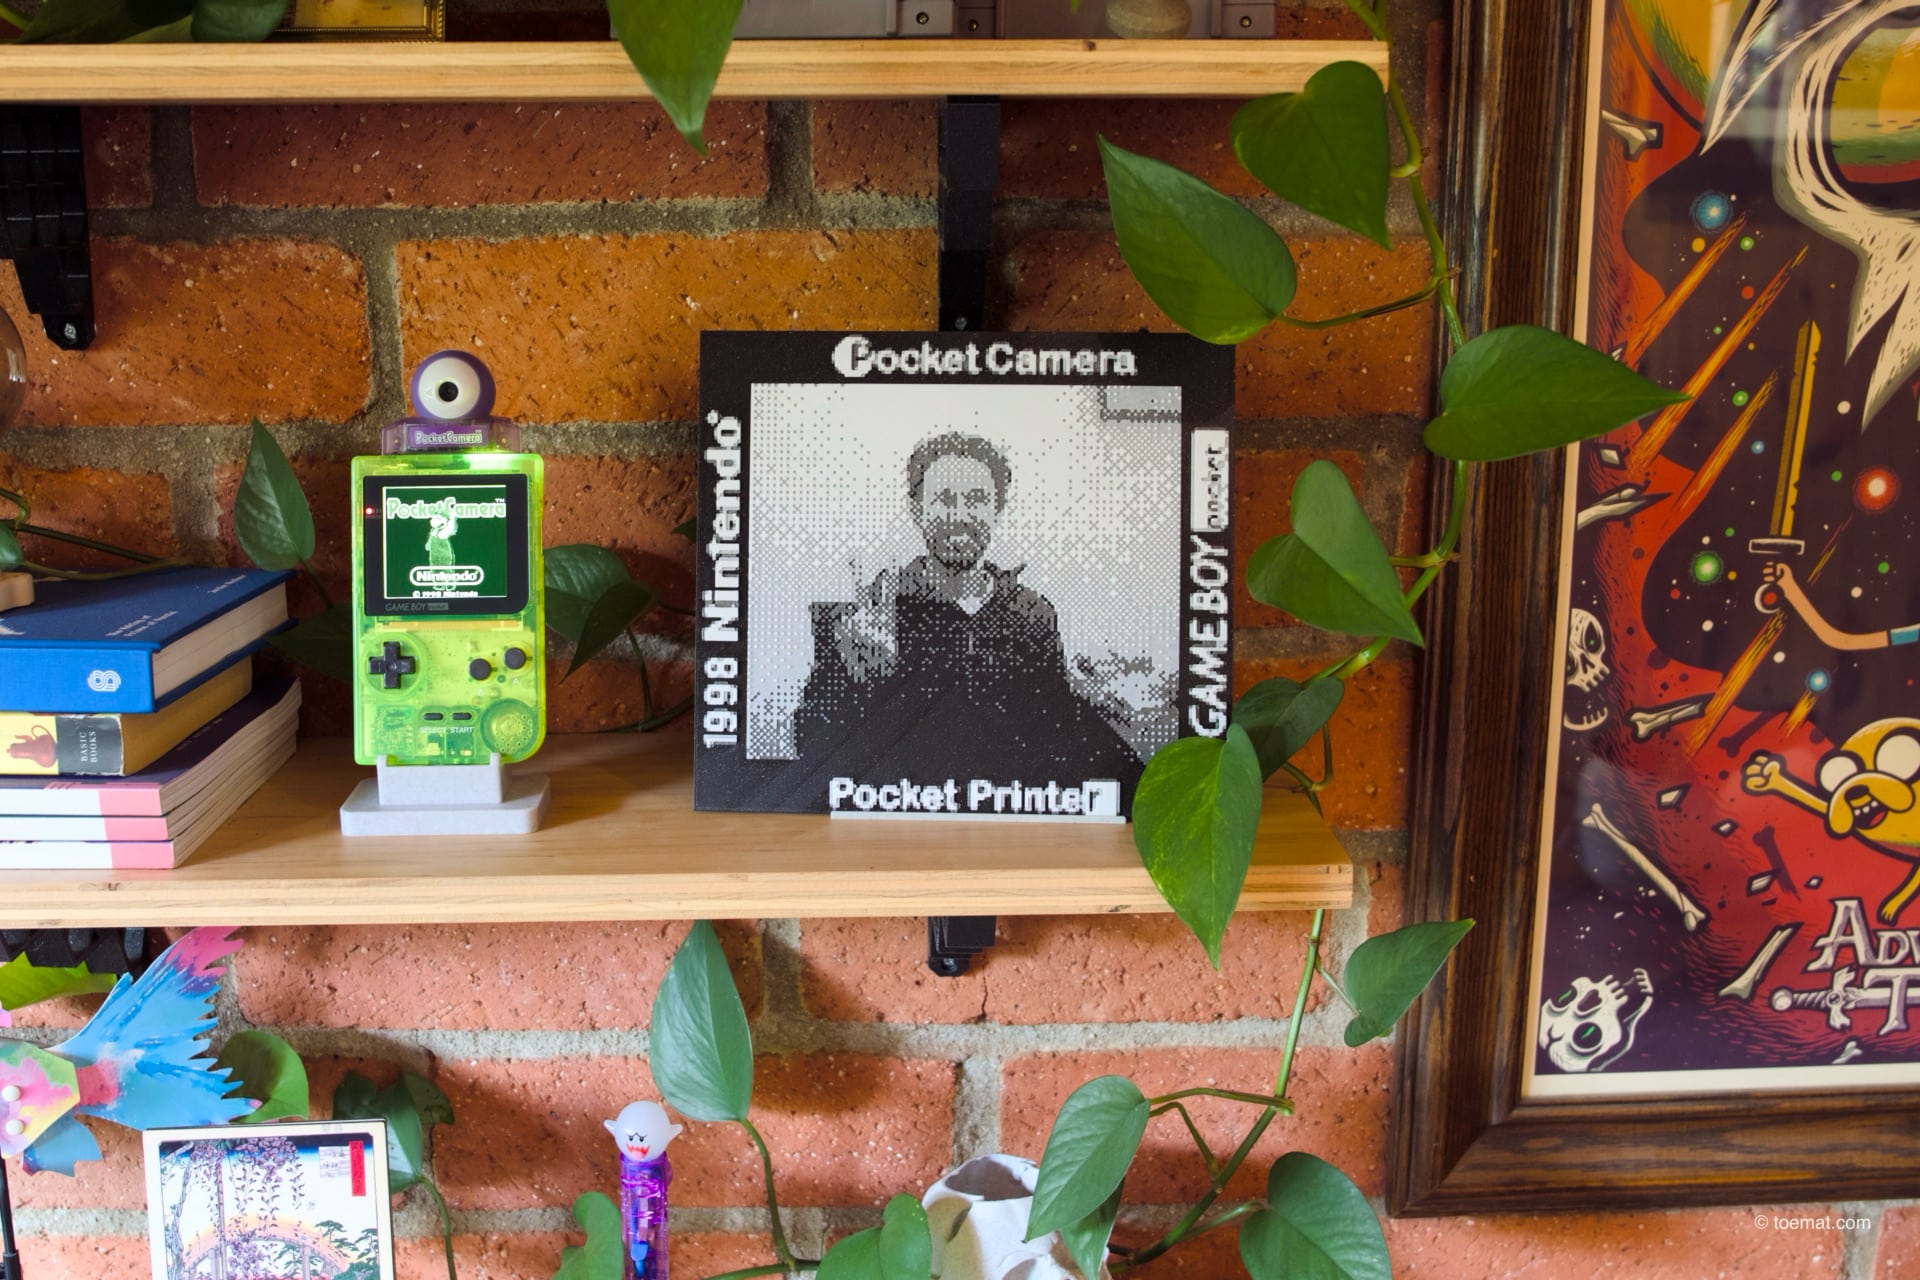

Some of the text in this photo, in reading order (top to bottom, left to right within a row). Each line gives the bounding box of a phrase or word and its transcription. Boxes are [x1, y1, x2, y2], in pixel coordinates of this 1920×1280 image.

[985, 342, 1137, 376] Camera
[1190, 535, 1228, 615] BOY
[1188, 617, 1228, 738] GAME
[703, 657, 738, 749] 1998
[79, 731, 88, 762] BASIC
[88, 730, 98, 763] BOOKS
[830, 777, 960, 812] Pocket
